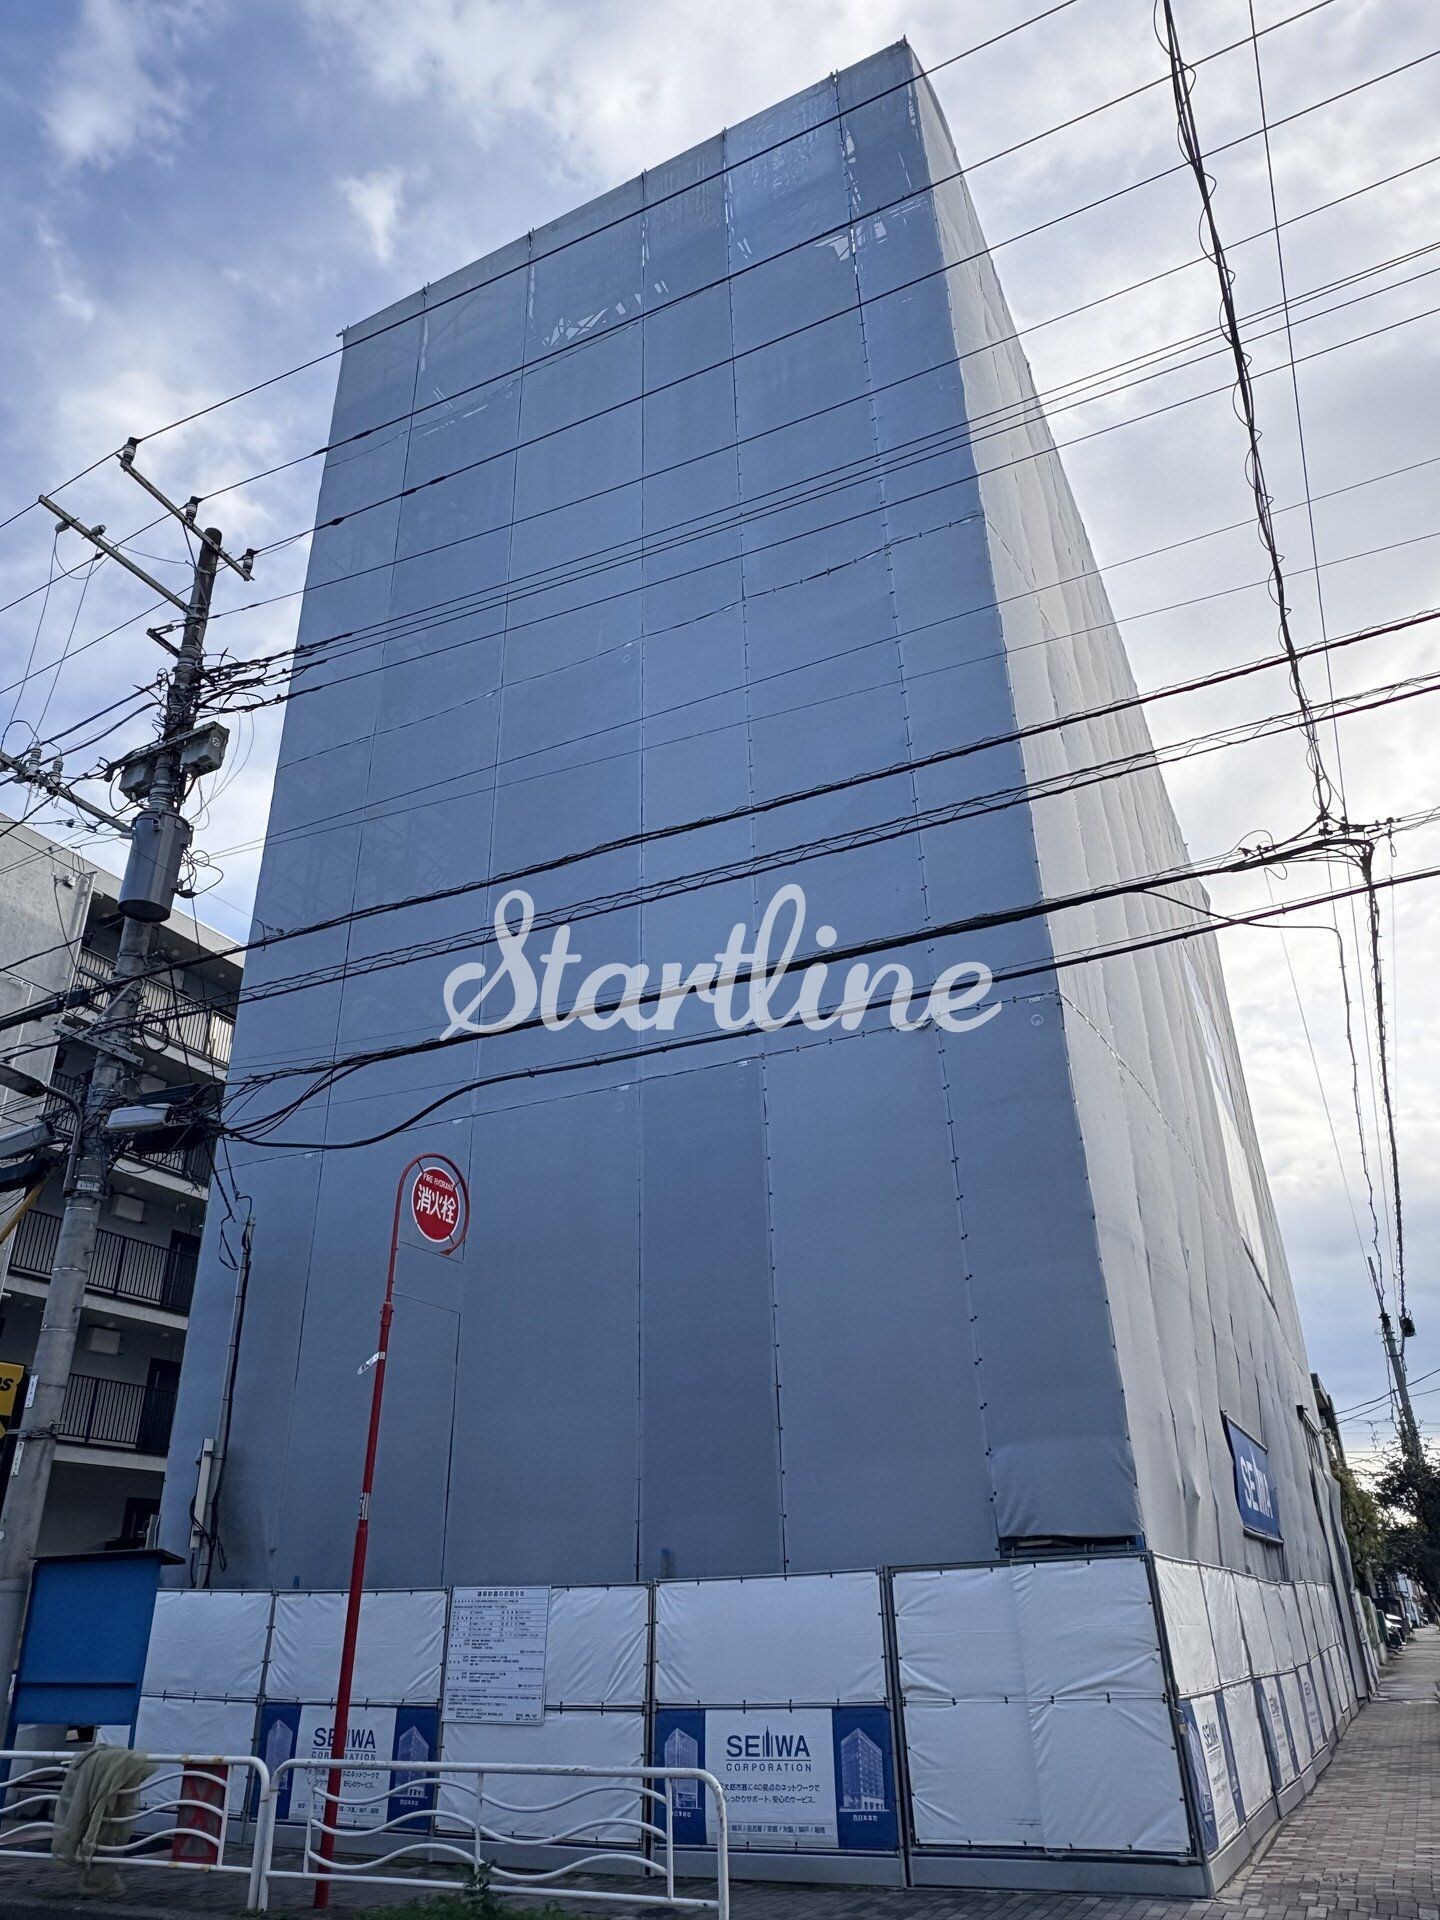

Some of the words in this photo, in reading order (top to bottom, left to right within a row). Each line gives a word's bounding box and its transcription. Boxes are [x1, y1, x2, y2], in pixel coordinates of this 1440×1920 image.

[416, 1184, 455, 1225] 消火栓
[726, 1763, 812, 1772] CORPORATION
